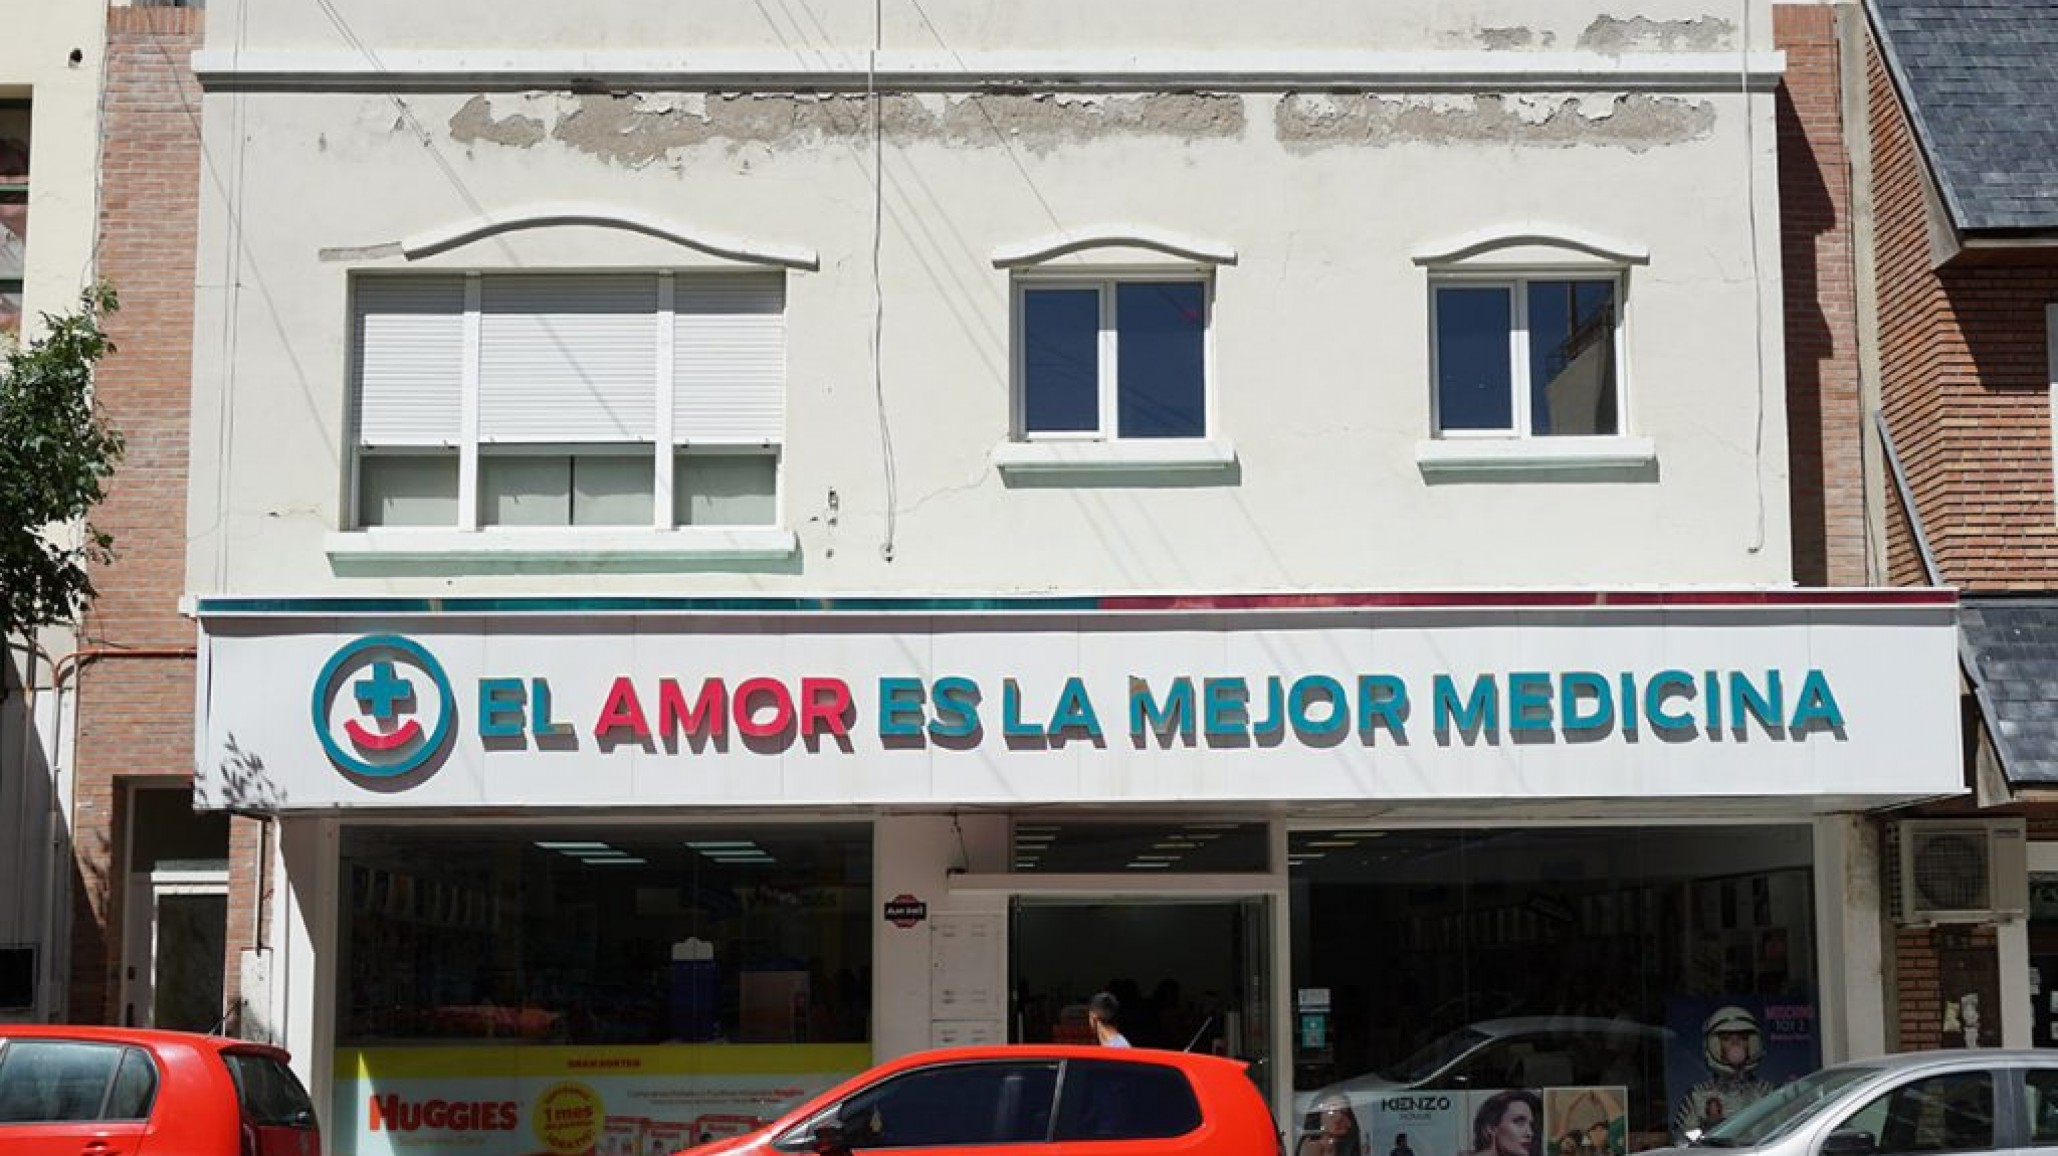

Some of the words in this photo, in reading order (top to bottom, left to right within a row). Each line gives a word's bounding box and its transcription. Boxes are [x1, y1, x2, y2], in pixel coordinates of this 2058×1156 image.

[478, 677, 579, 752] EL
[594, 676, 857, 754] AMOR
[879, 676, 983, 750] ES
[1002, 677, 1107, 750] LA
[1129, 674, 1409, 748] MEJOR
[1433, 669, 1848, 747] MEDICINA
[368, 1093, 518, 1132] HUGGIES
[1382, 1097, 1451, 1112] KENZO
